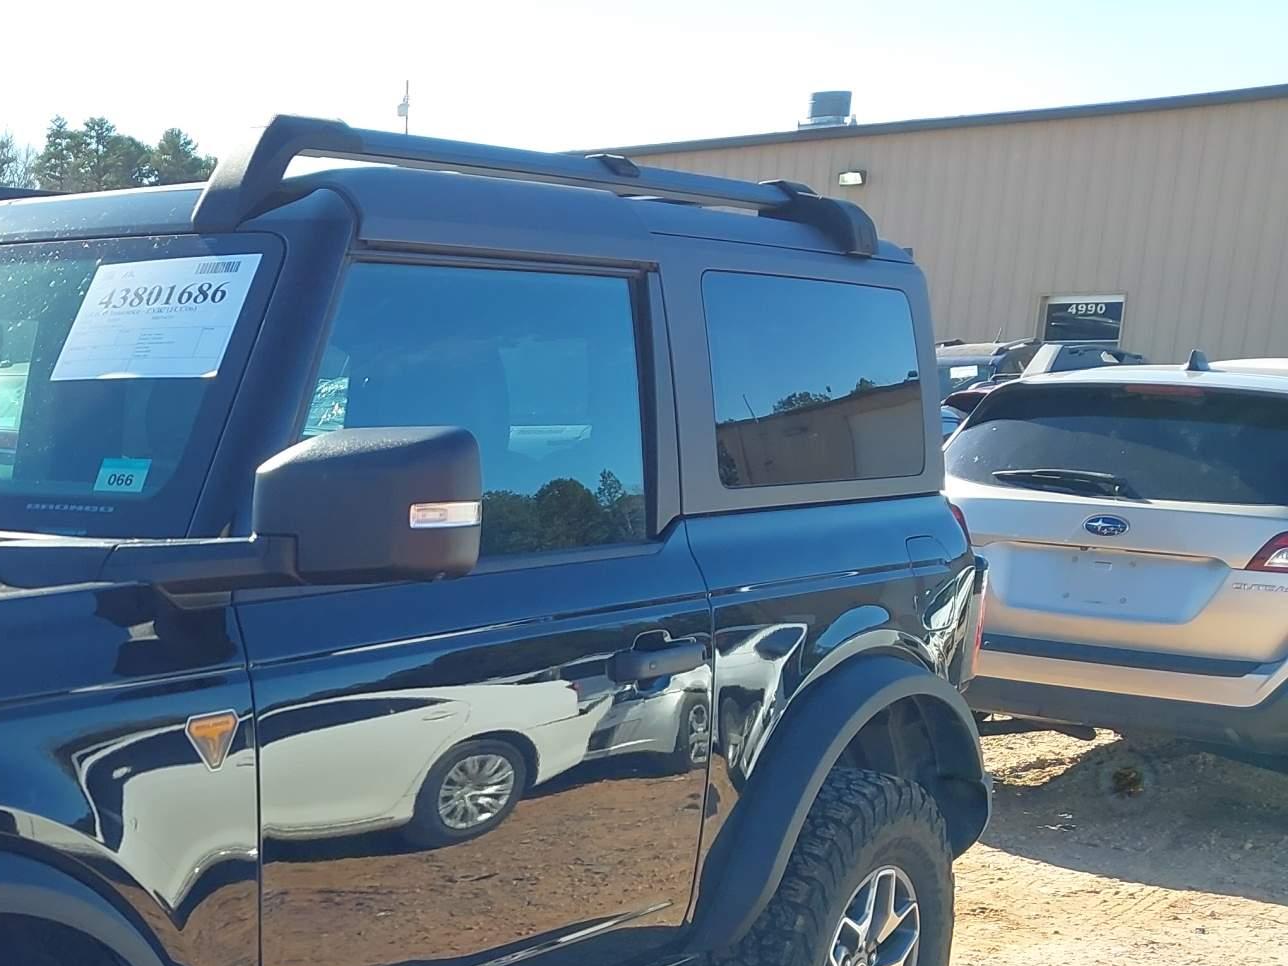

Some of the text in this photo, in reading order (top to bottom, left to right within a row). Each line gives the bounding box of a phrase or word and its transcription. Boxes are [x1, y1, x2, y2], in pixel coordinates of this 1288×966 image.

[97, 281, 231, 310] 43801686
[1067, 303, 1106, 315] 4990
[107, 473, 135, 487] 066
